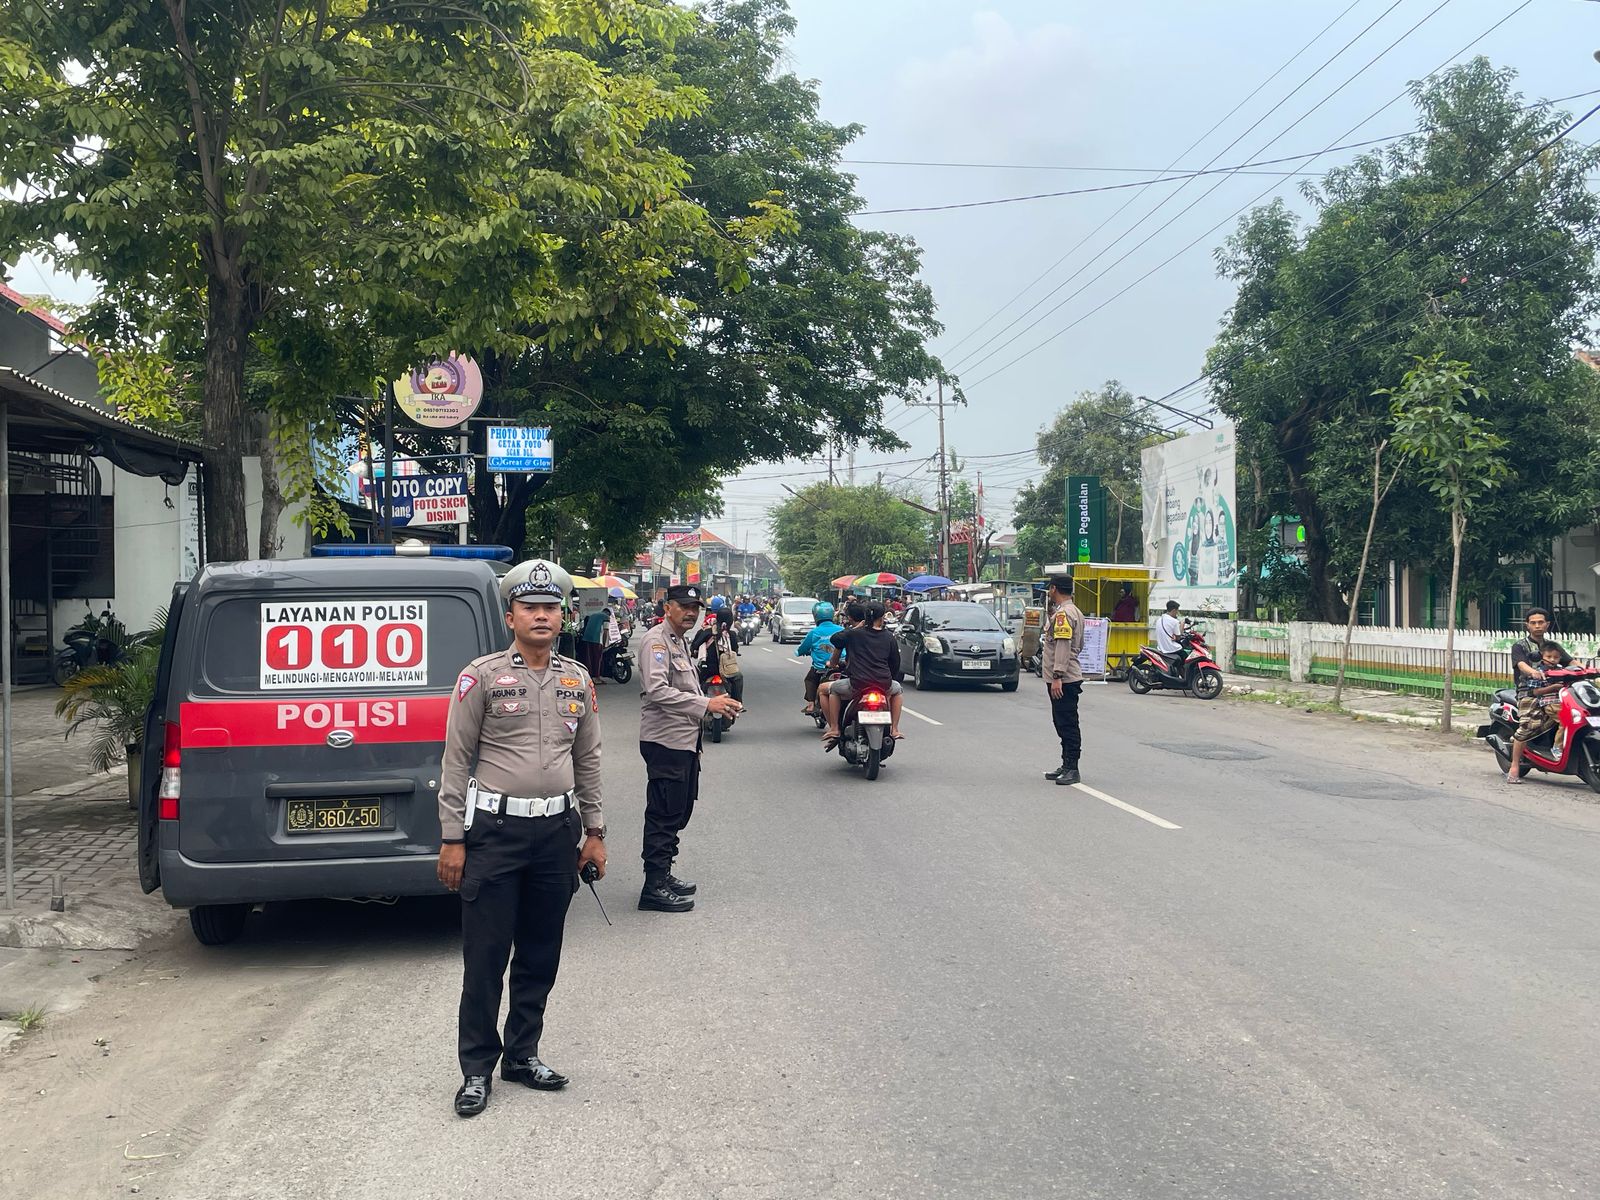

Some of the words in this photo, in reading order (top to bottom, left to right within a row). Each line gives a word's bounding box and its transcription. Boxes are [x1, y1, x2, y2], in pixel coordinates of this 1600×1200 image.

[490, 428, 517, 440] PHOTO
[498, 440, 521, 449] CETAK
[524, 440, 542, 449] FOTO
[425, 476, 463, 496] COPY
[414, 499, 438, 511] FOTO
[440, 496, 467, 508] SKCK
[426, 510, 457, 523] DISINI
[265, 606, 356, 622] LAYANAN
[362, 604, 423, 621] POLISI
[491, 689, 516, 698] AGUNG
[518, 688, 527, 697] SP
[556, 689, 585, 699] POLRI
[277, 701, 407, 730] POLISI
